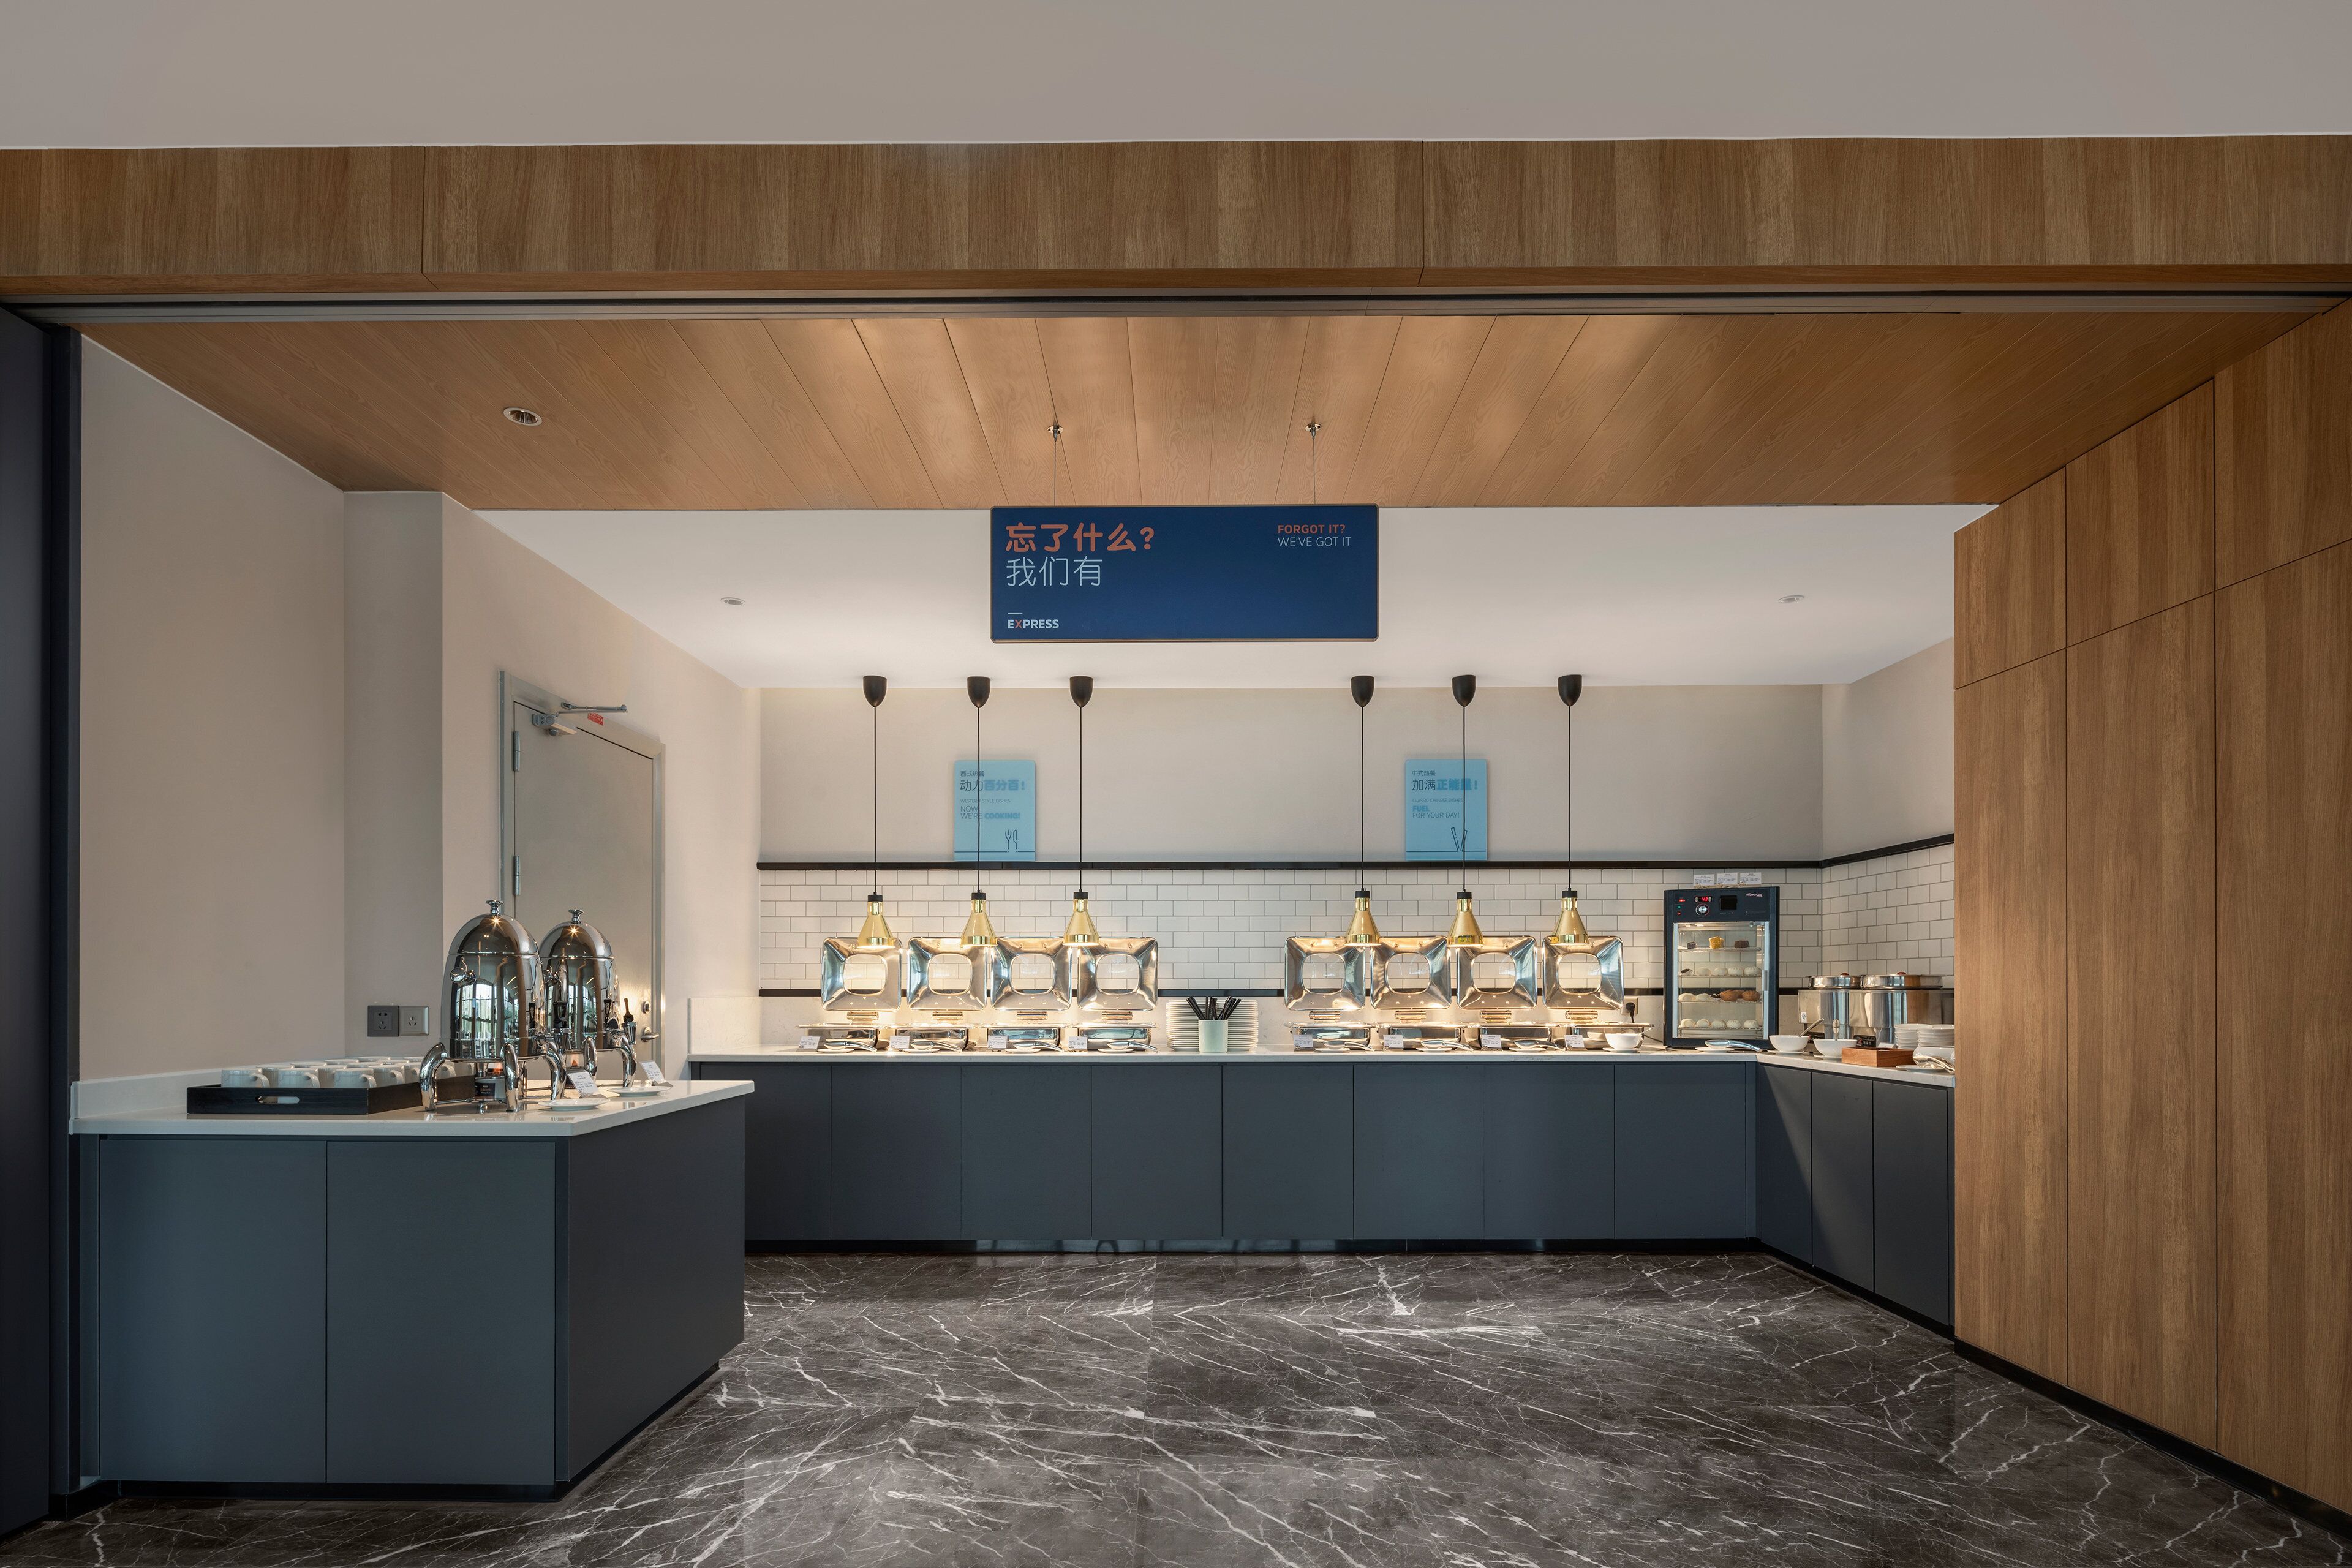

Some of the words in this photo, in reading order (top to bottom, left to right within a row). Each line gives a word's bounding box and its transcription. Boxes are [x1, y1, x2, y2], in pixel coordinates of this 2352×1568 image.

[1278, 524, 1324, 534] FORGOT
[1329, 524, 1346, 534] IT?
[1006, 522, 1155, 552] 忘了什么?
[1278, 536, 1313, 547] WE'VE
[1316, 536, 1338, 547] GOT
[1341, 536, 1351, 546] IT
[1006, 556, 1103, 586] 我们有
[1008, 619, 1059, 629] EXPRESS
